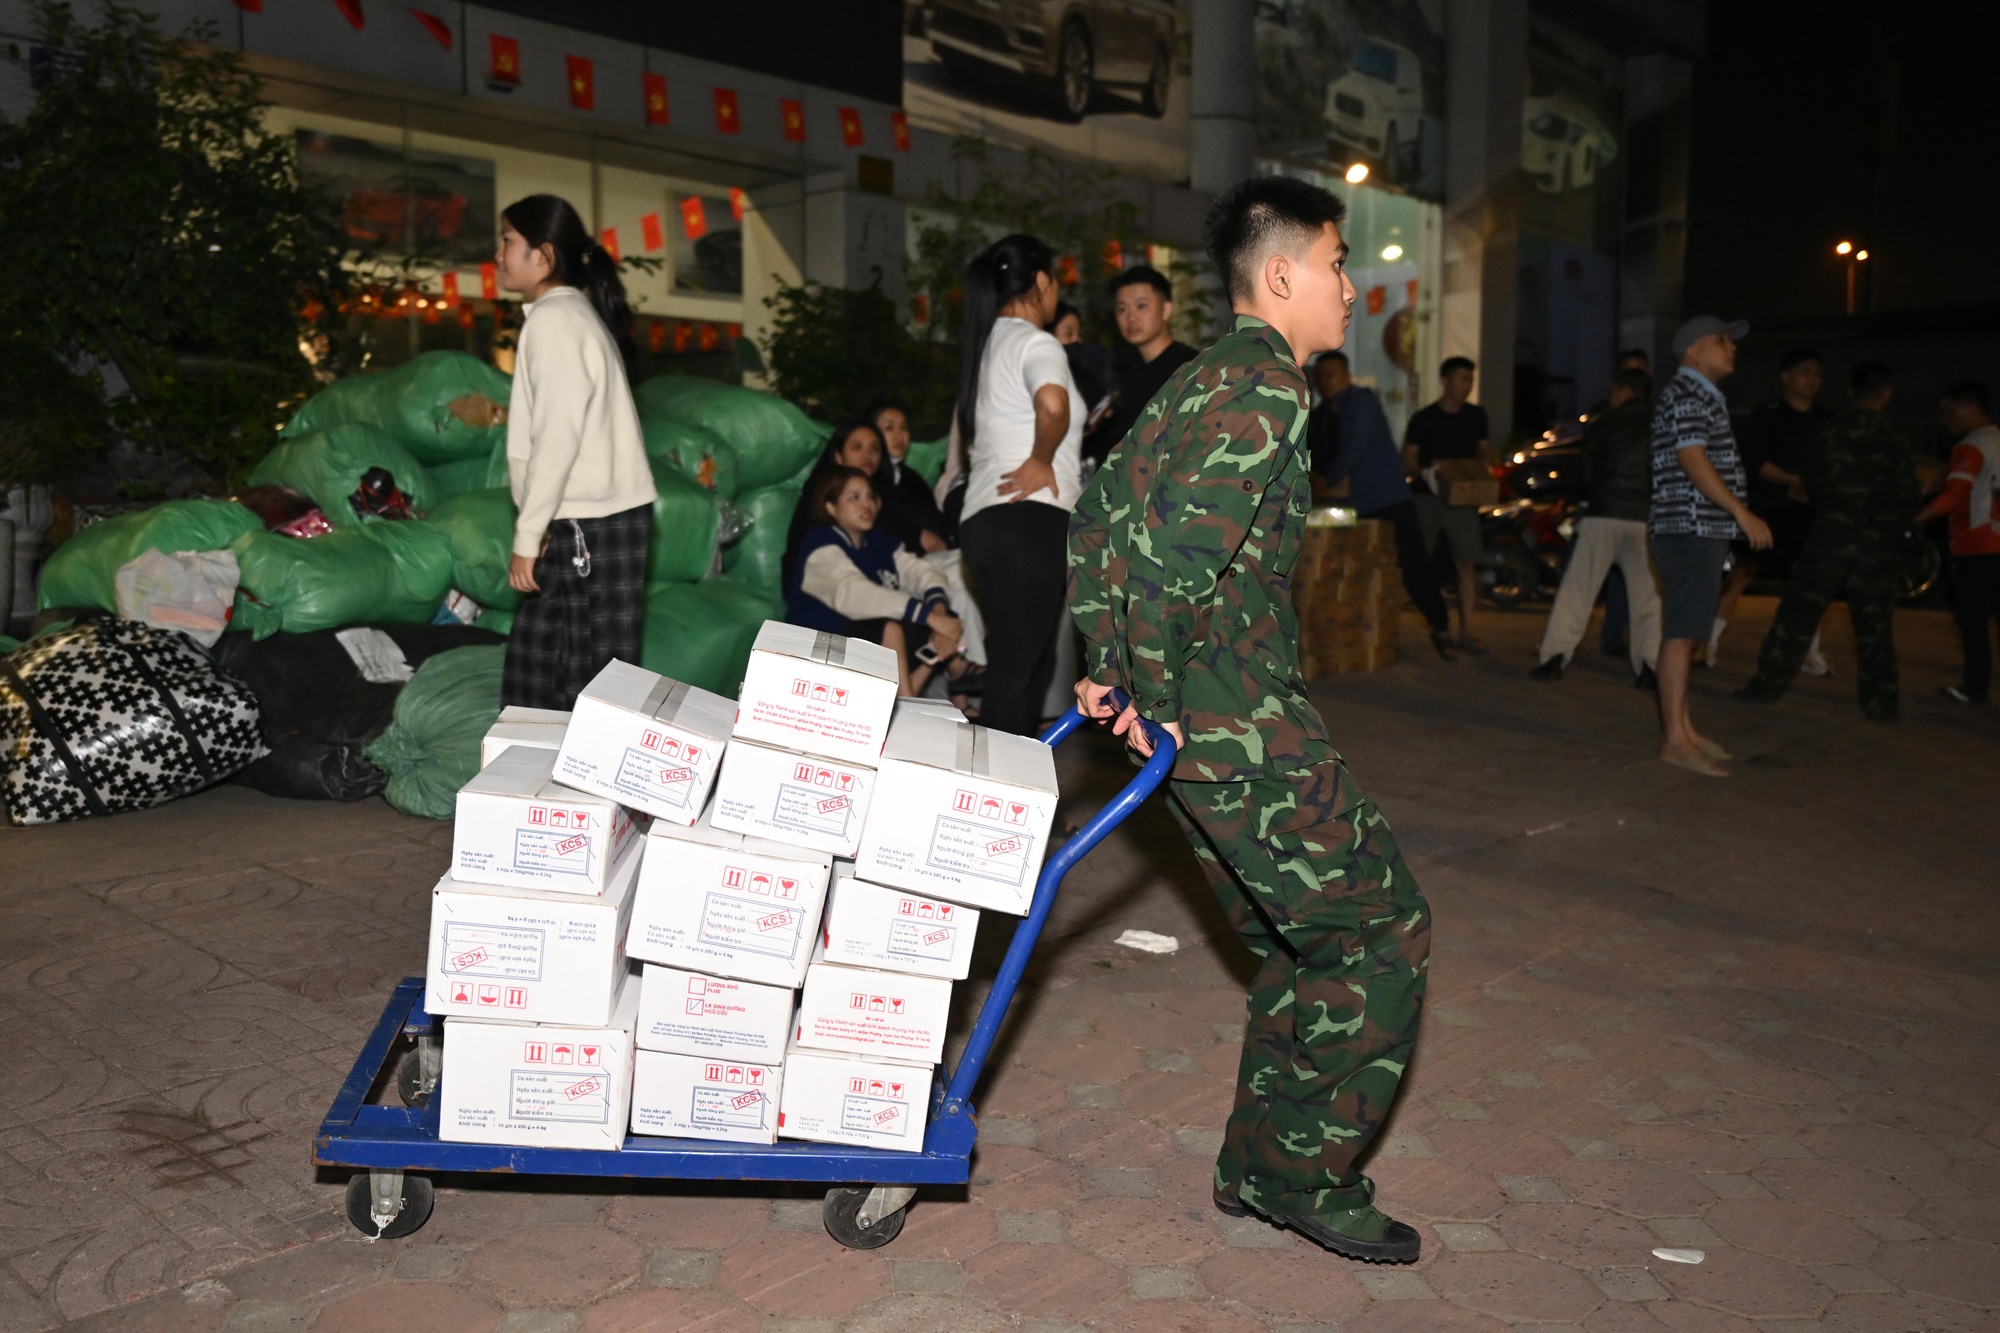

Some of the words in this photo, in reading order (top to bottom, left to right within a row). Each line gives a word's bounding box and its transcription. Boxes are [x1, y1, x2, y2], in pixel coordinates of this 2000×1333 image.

[665, 770, 687, 780] KCS
[822, 798, 844, 810] KCS
[561, 838, 582, 851] KCS
[991, 840, 1016, 853] KCS
[763, 915, 787, 928] KCS
[927, 933, 945, 942] KCS
[457, 952, 482, 966] KCS
[571, 1082, 594, 1096] KCS
[736, 1094, 757, 1106] KCS
[878, 1111, 895, 1121] KCS
